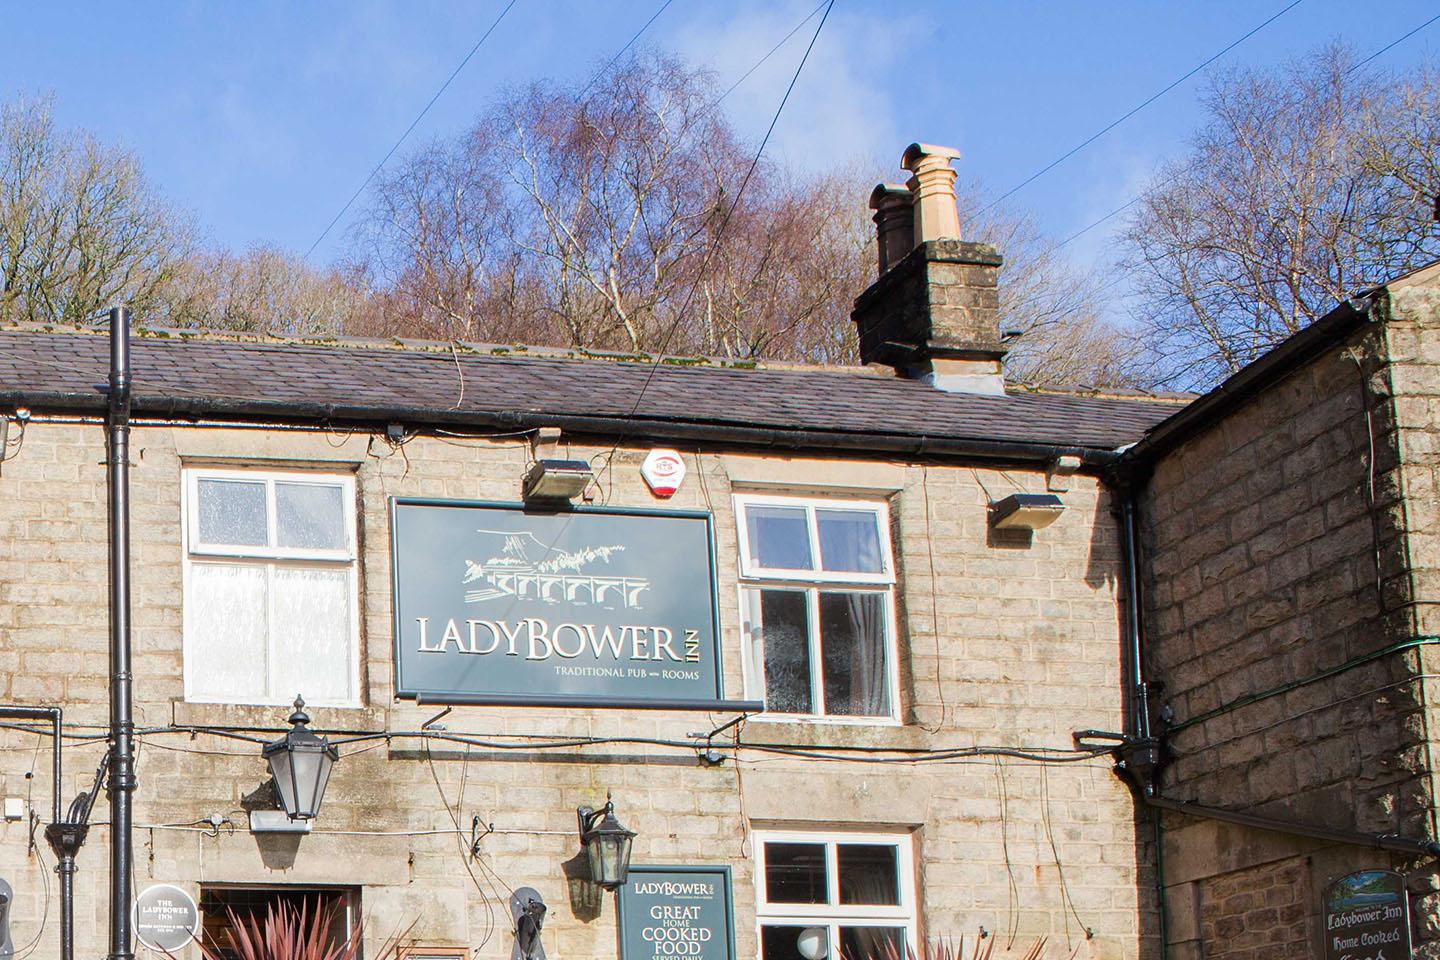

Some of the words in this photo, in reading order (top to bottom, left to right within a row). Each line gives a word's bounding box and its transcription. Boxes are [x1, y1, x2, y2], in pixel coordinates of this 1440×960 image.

[416, 617, 683, 662] LADYBOWER
[686, 630, 700, 663] INN
[554, 666, 624, 678] TRADITIONAL
[628, 669, 647, 678] PUB
[662, 670, 700, 681] ROOMS
[635, 882, 708, 895] LADYBOWER
[650, 906, 700, 919] GREAT
[1327, 910, 1382, 930] Ladybower
[642, 928, 711, 941] COOKED
[1361, 928, 1400, 946] Cooked
[655, 942, 700, 954] FOOD
